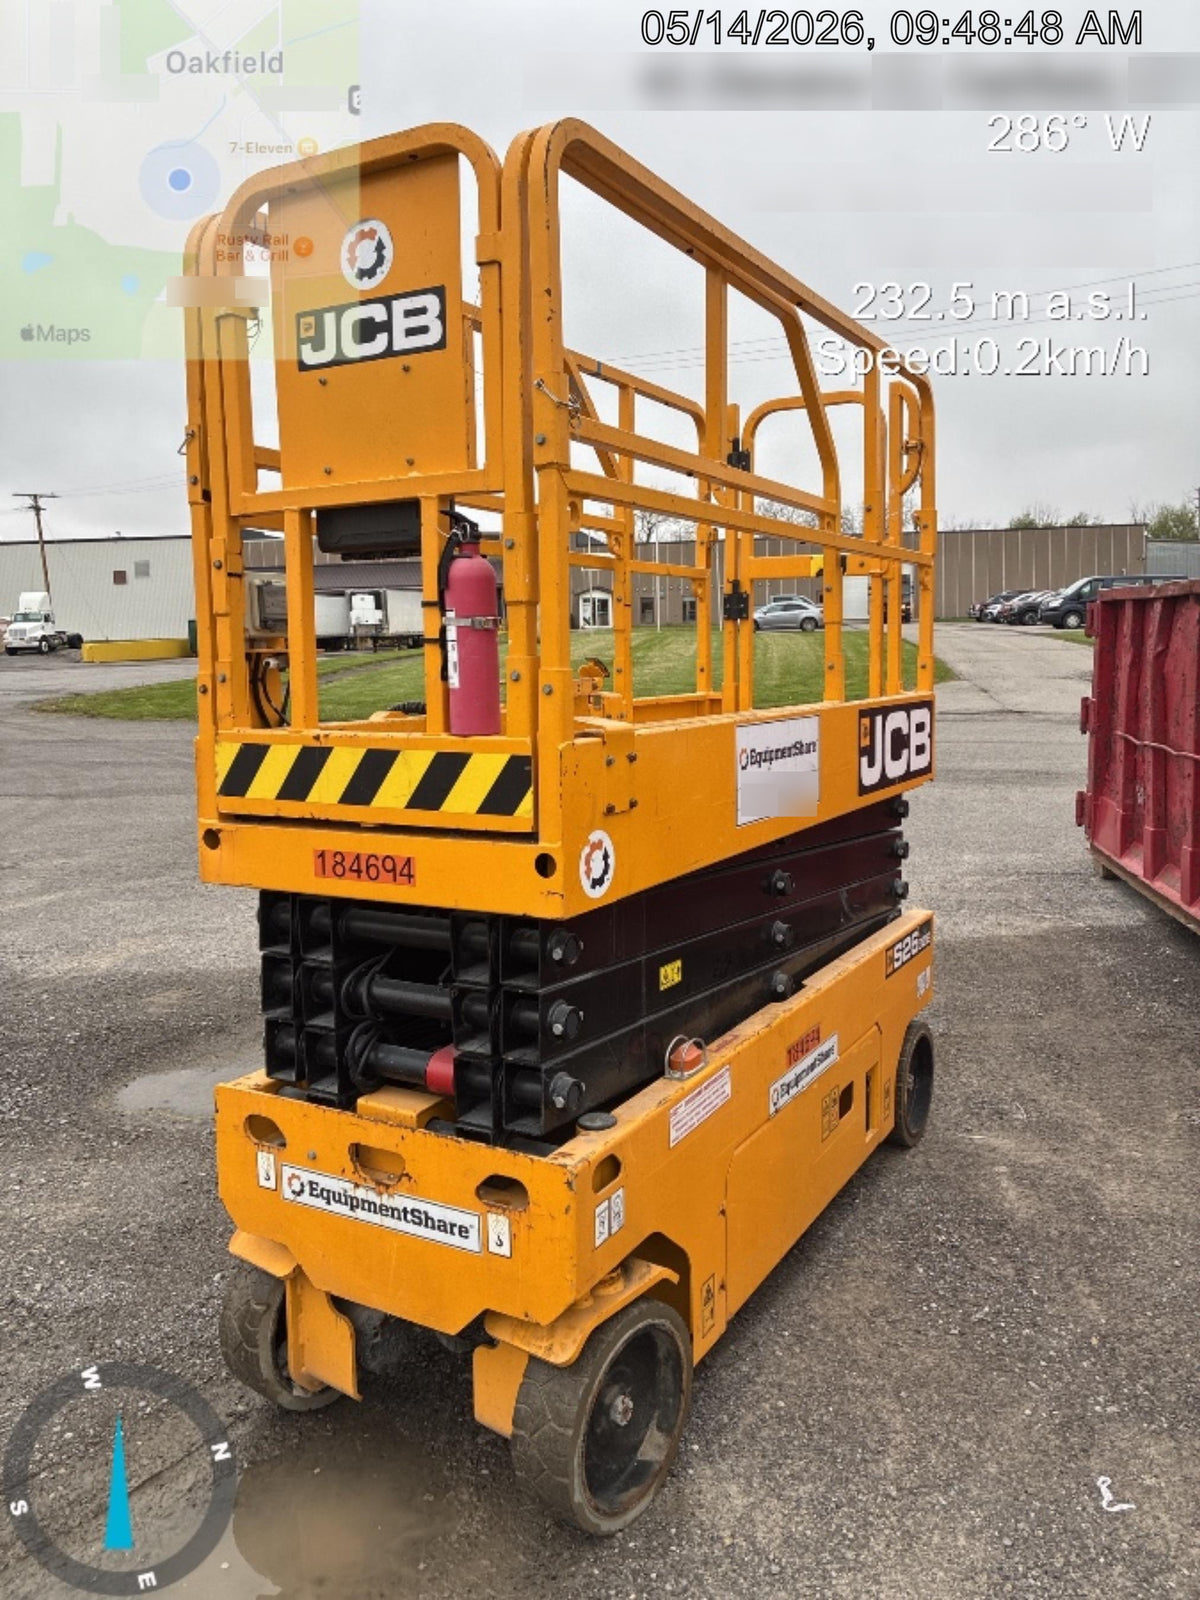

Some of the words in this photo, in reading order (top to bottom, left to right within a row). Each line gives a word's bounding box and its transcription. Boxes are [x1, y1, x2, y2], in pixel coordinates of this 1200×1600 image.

[300, 292, 443, 366] JCB
[750, 739, 817, 769] EquipmentShare
[860, 707, 931, 787] JCB
[317, 849, 414, 884] 184694
[308, 1179, 471, 1240] EquipmentShare
